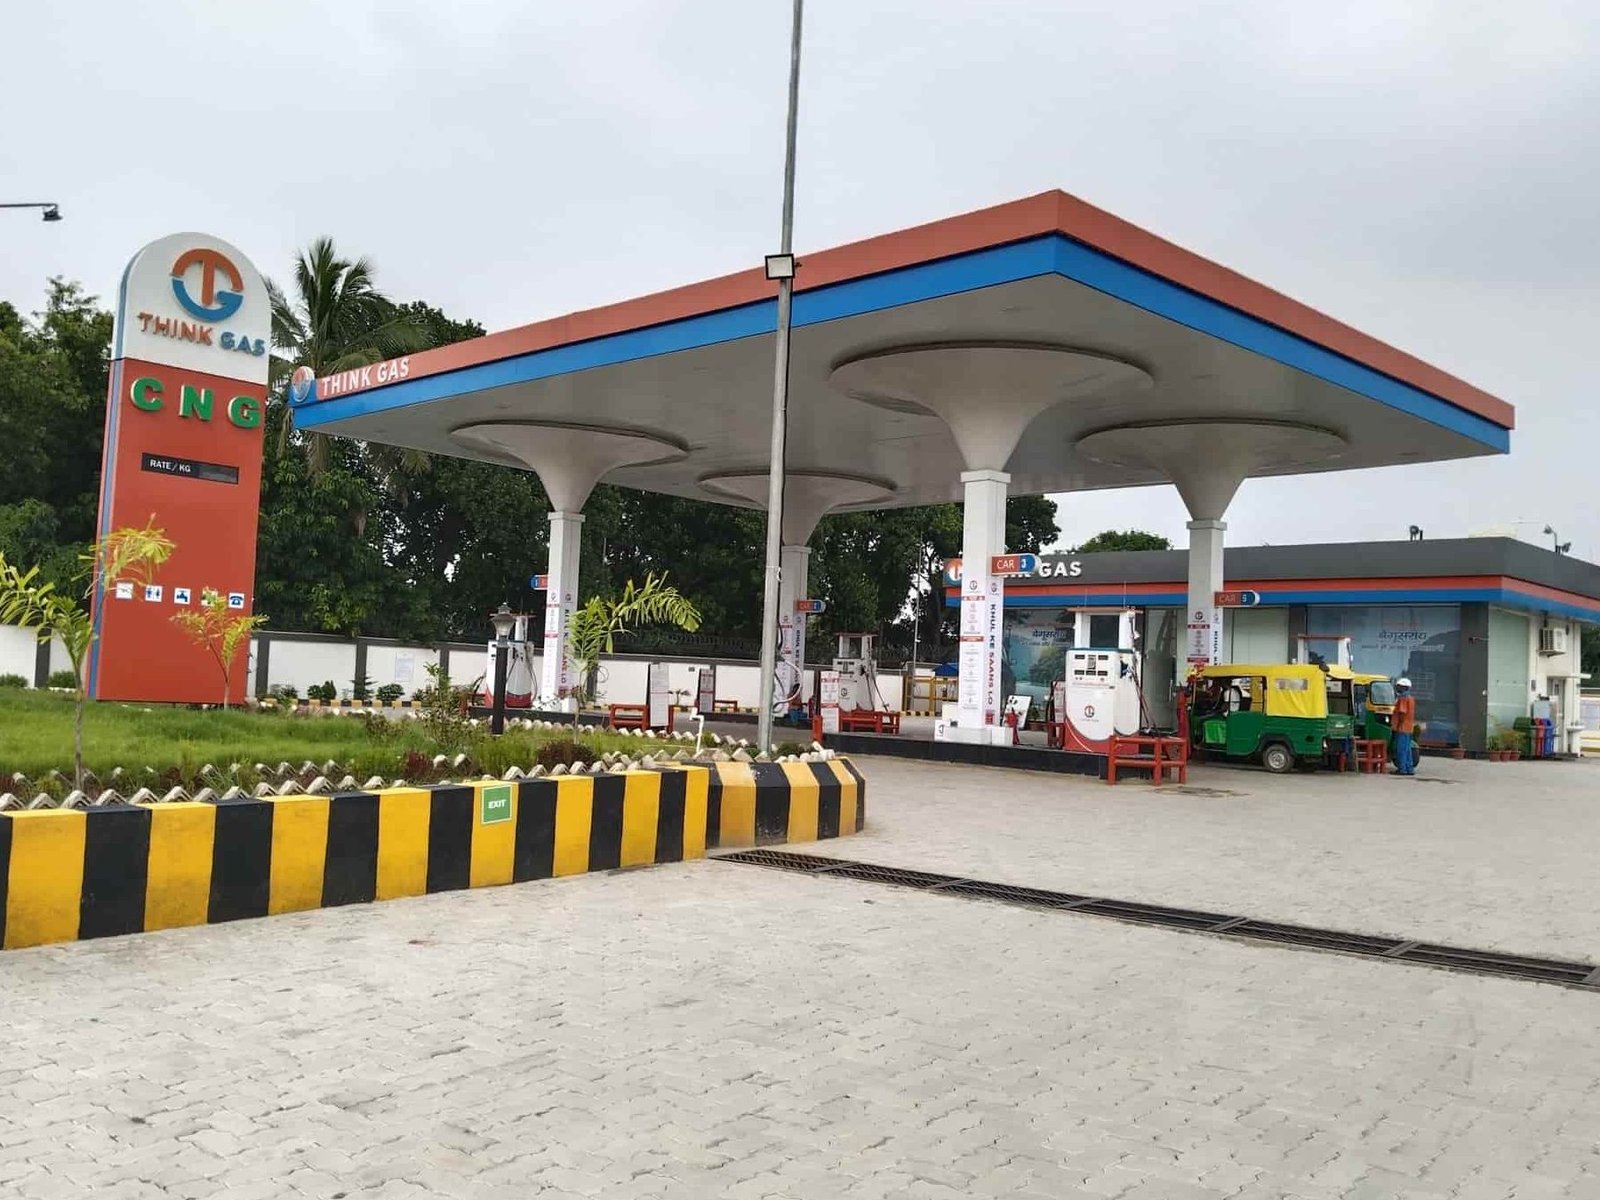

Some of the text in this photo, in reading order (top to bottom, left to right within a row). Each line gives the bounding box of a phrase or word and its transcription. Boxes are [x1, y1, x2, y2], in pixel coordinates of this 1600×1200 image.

[137, 312, 266, 356] THINK GAS
[321, 358, 410, 396] THINK GAS
[997, 559, 1015, 570] CAR
[1040, 561, 1082, 577] GAS
[488, 799, 506, 809] EXIT
